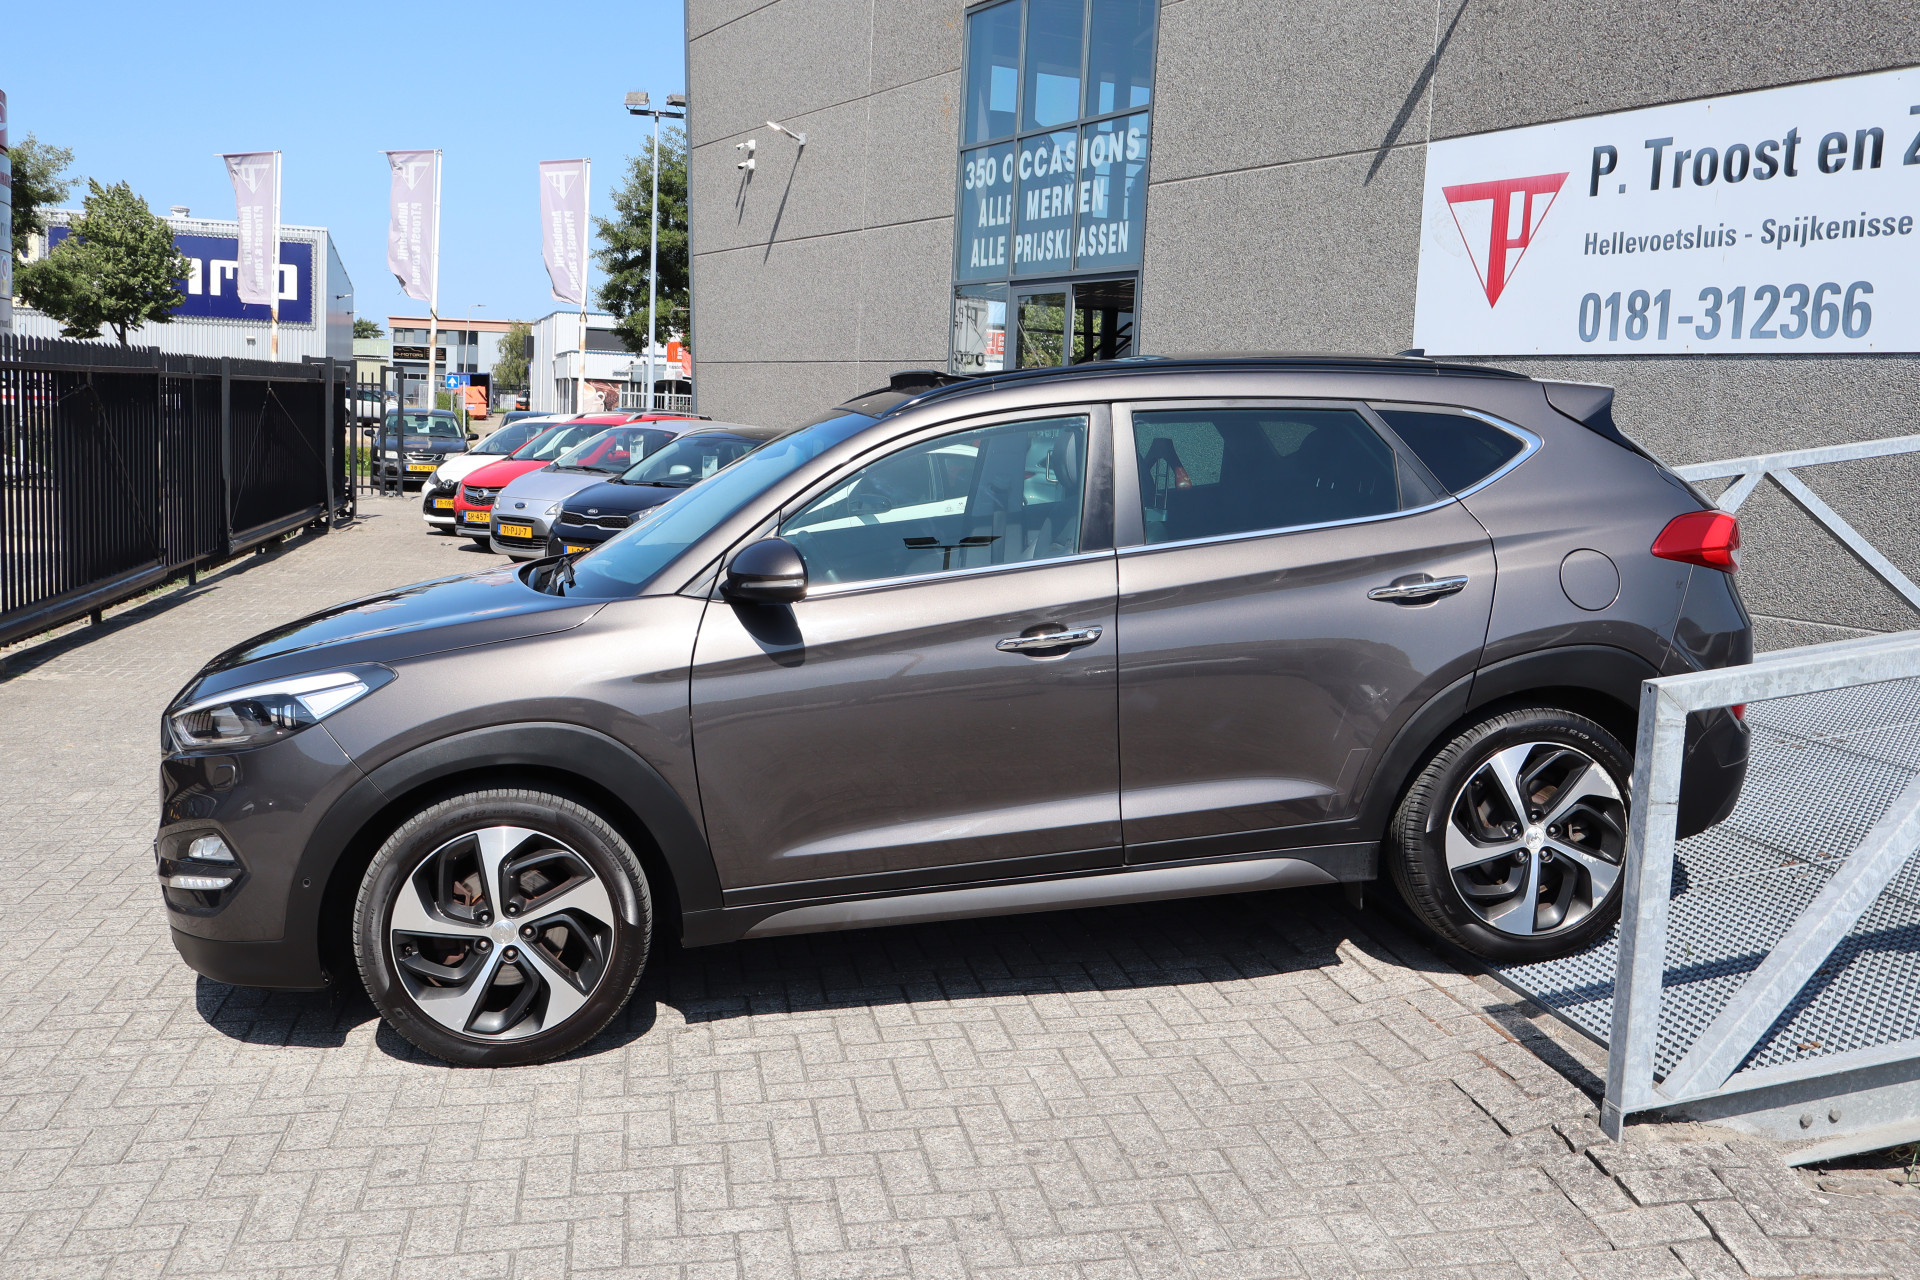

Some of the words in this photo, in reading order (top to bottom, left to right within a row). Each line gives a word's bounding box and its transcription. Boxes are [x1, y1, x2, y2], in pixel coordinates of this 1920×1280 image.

[965, 154, 997, 190] 350
[1002, 127, 1141, 184] OCCASIONS
[1589, 144, 1627, 197] P.
[1644, 126, 1802, 191] Troost
[1817, 125, 1885, 175] en
[977, 197, 1012, 228] ALLE
[1026, 179, 1105, 221] MERKEN
[970, 235, 1005, 268] ALLE
[1584, 222, 1738, 256] Hellevoetsluis
[1760, 211, 1914, 250] Spijkenisse
[1578, 280, 1875, 343] 0181-312366
